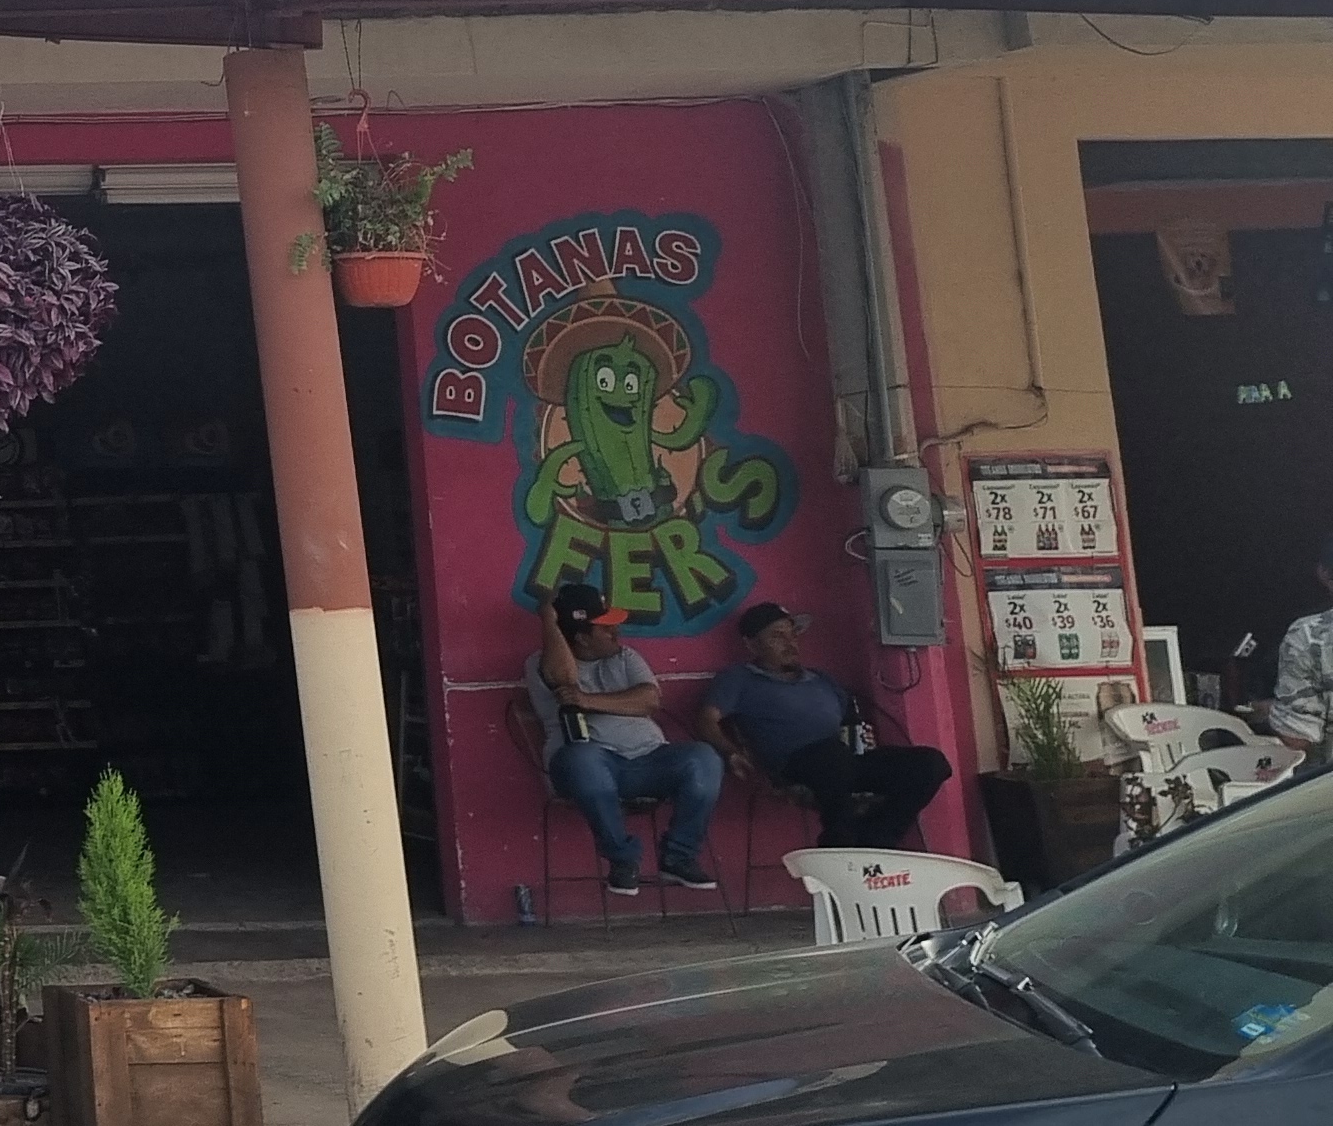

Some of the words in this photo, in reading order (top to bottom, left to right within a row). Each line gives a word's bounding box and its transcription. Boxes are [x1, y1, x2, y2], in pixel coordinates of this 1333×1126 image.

[433, 226, 702, 422] BOTANAS
[989, 490, 1008, 505] 2x
[1035, 490, 1054, 505] 2x
[1077, 489, 1095, 504] 2x
[985, 506, 1013, 521] $78
[1033, 505, 1057, 520] $71
[1073, 505, 1099, 519] $67
[1007, 601, 1026, 616] 2x
[1052, 600, 1070, 614] 2x
[1092, 600, 1109, 614] 2x
[1005, 615, 1033, 630] $40
[865, 872, 912, 890] TECATE
